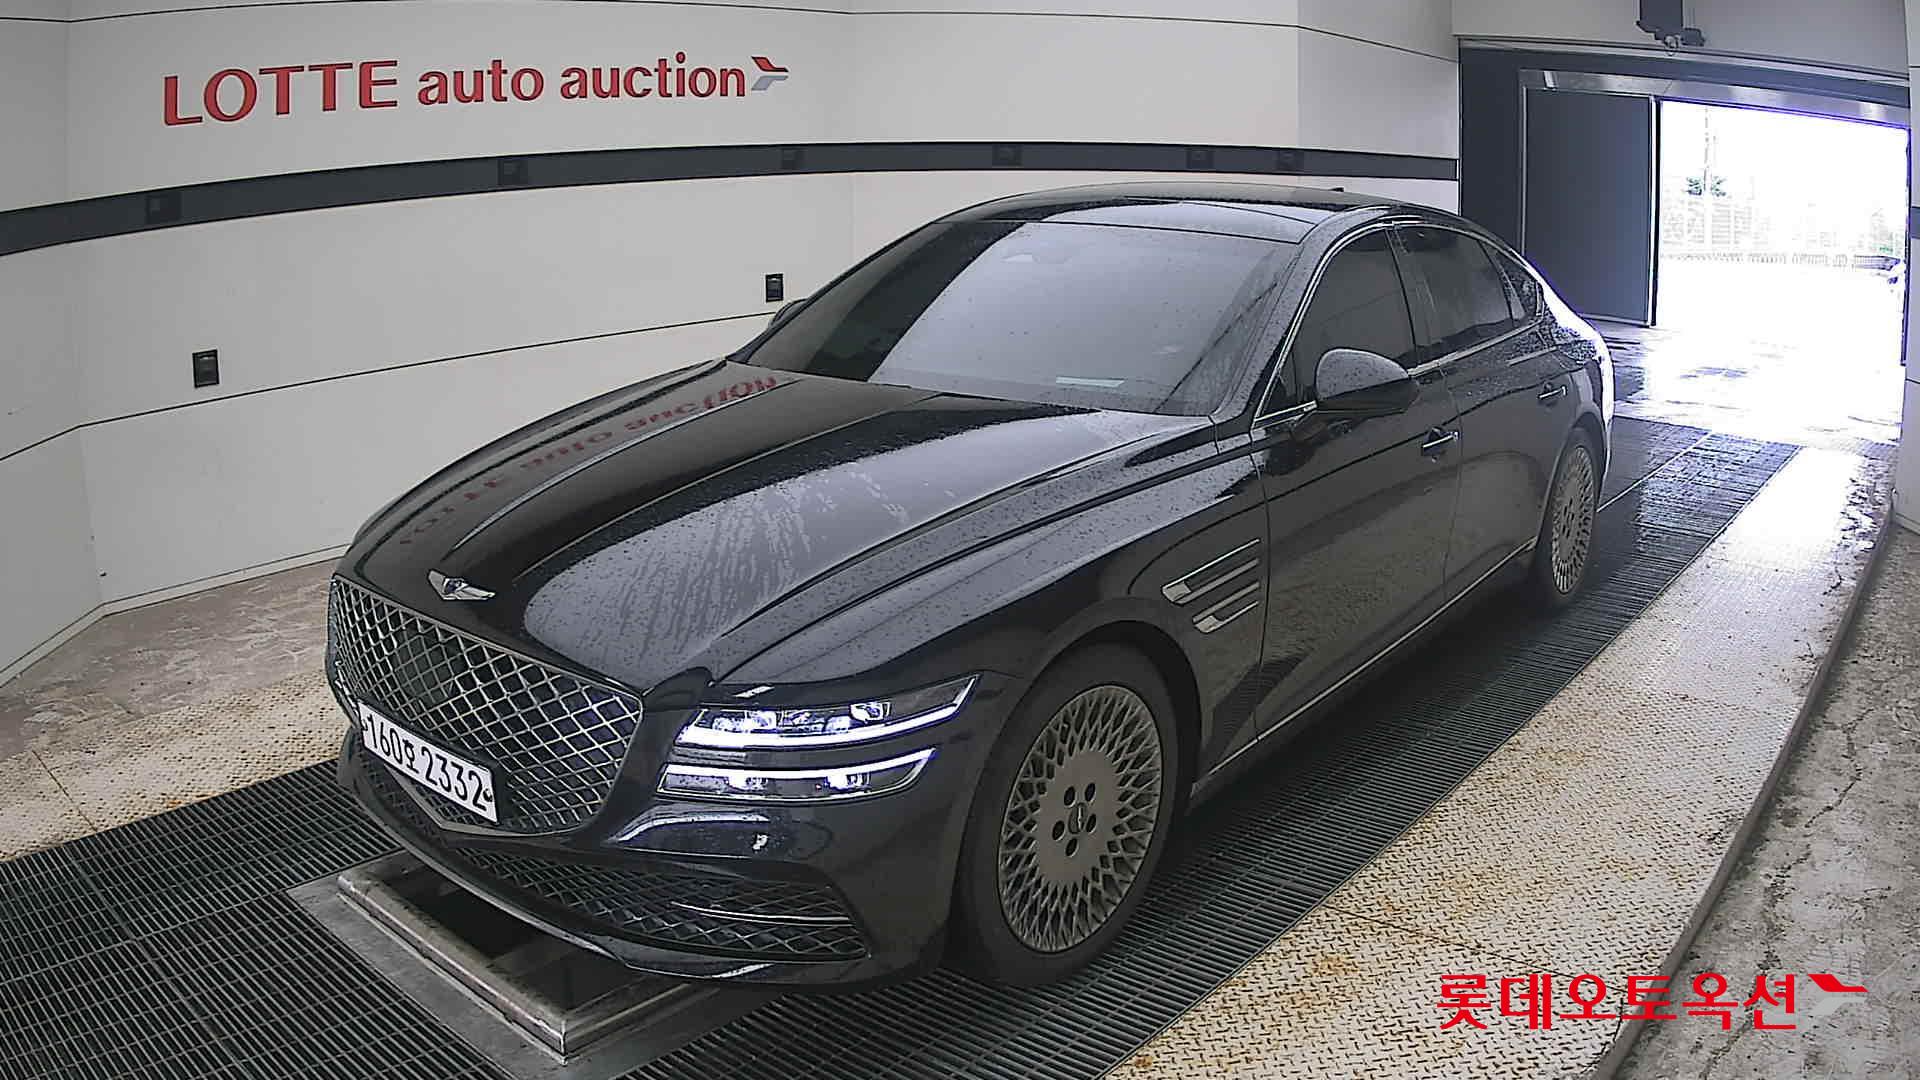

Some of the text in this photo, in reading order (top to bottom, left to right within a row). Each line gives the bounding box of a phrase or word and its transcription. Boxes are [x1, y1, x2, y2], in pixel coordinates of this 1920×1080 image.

[164, 52, 746, 125] LOTTE auto auction
